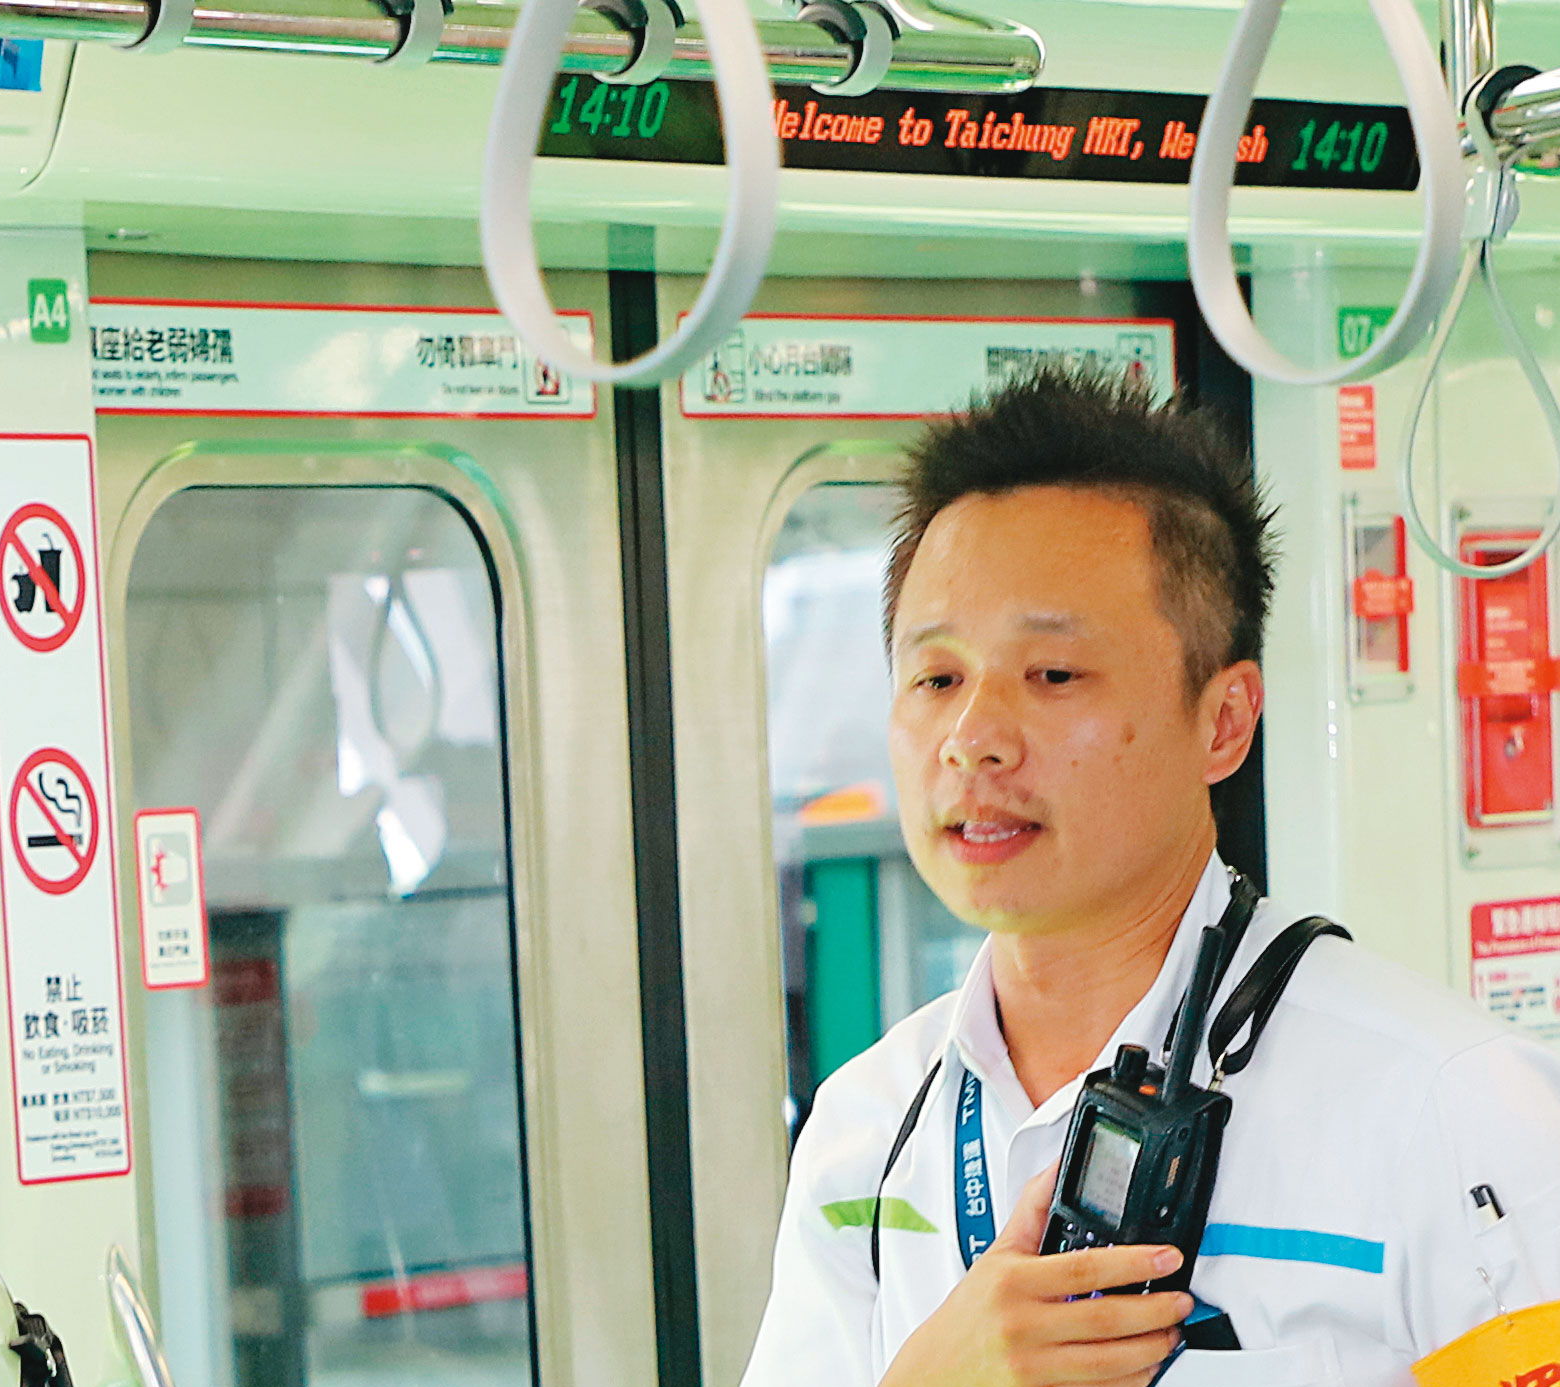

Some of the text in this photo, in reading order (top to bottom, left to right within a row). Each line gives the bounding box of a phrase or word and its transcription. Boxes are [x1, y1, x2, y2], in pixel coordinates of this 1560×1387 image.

[551, 76, 671, 138] 14:10
[899, 107, 933, 146] to
[944, 109, 1077, 161] Taichung
[1083, 116, 1144, 160] MRT,
[1159, 120, 1194, 160] We
[1292, 119, 1388, 172] 14:10
[33, 293, 67, 329] A4
[46, 973, 83, 1003] 禁止
